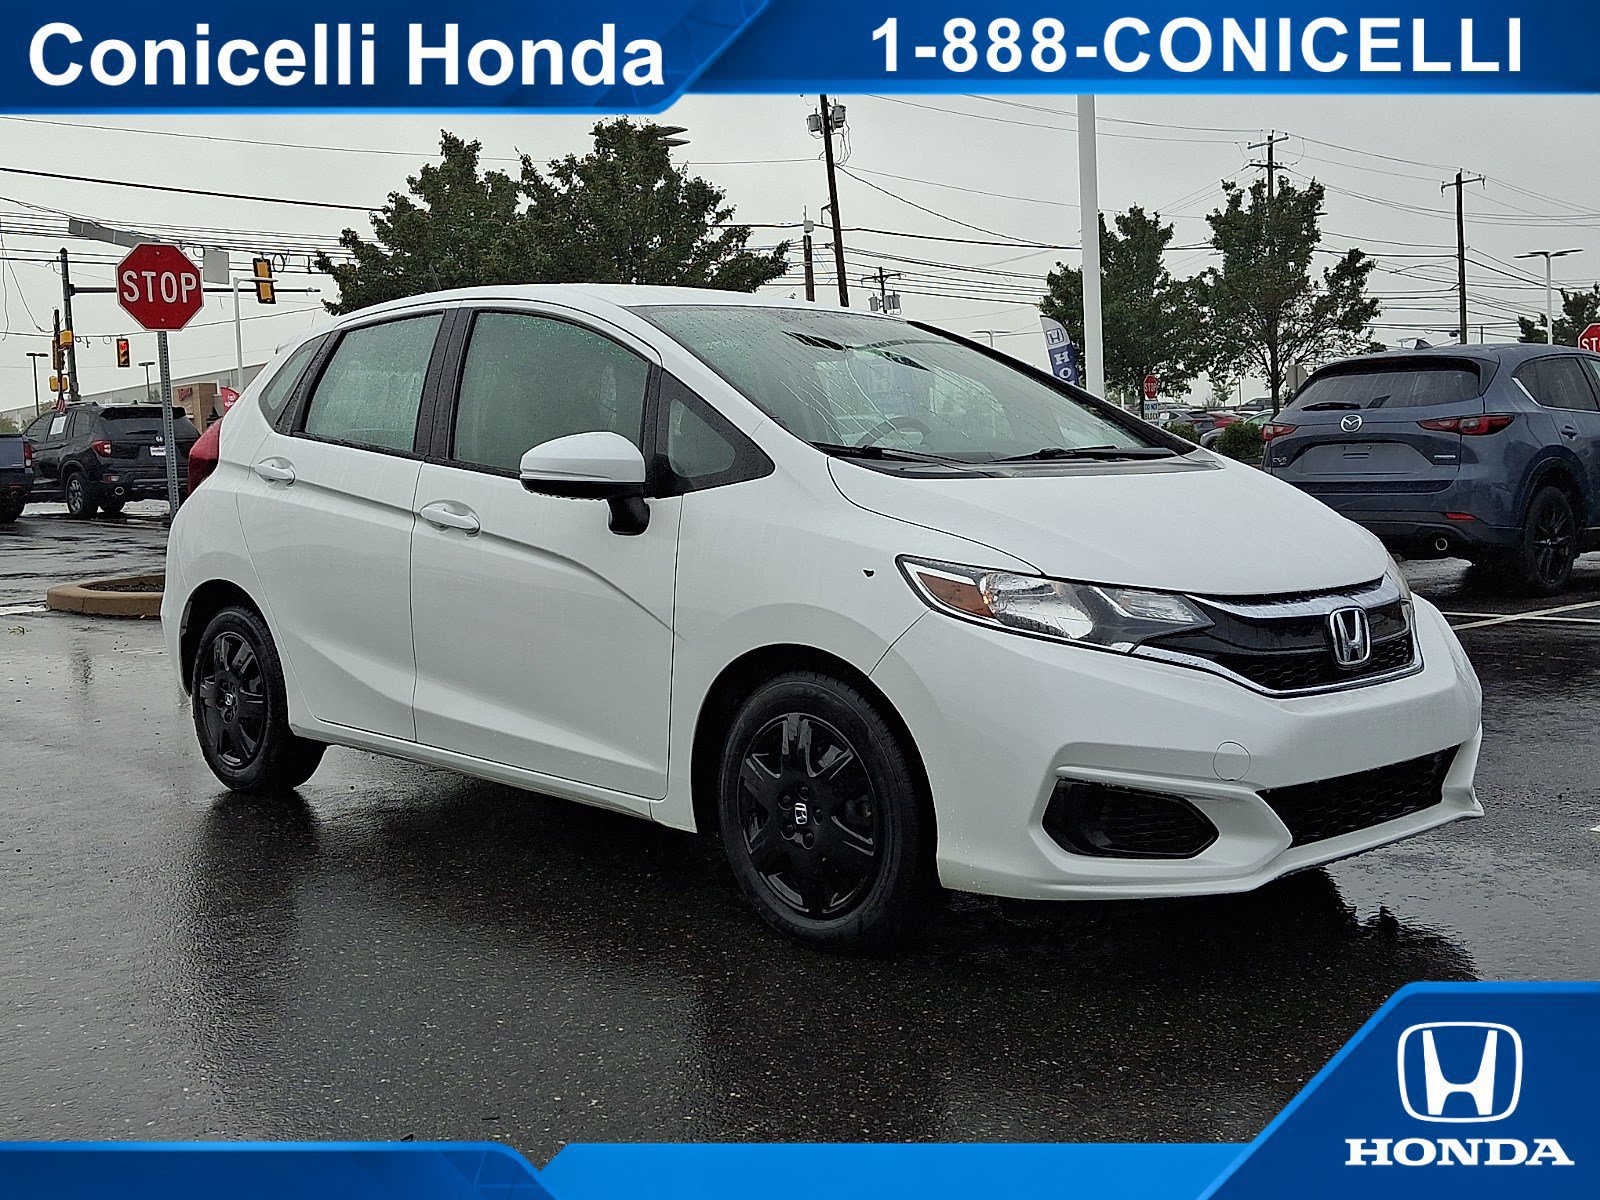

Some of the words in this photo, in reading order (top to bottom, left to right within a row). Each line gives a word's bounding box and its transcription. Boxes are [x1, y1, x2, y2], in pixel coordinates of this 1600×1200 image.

[122, 270, 197, 304] STOP
[1581, 336, 1600, 353] ST
[1144, 382, 1157, 393] STOP
